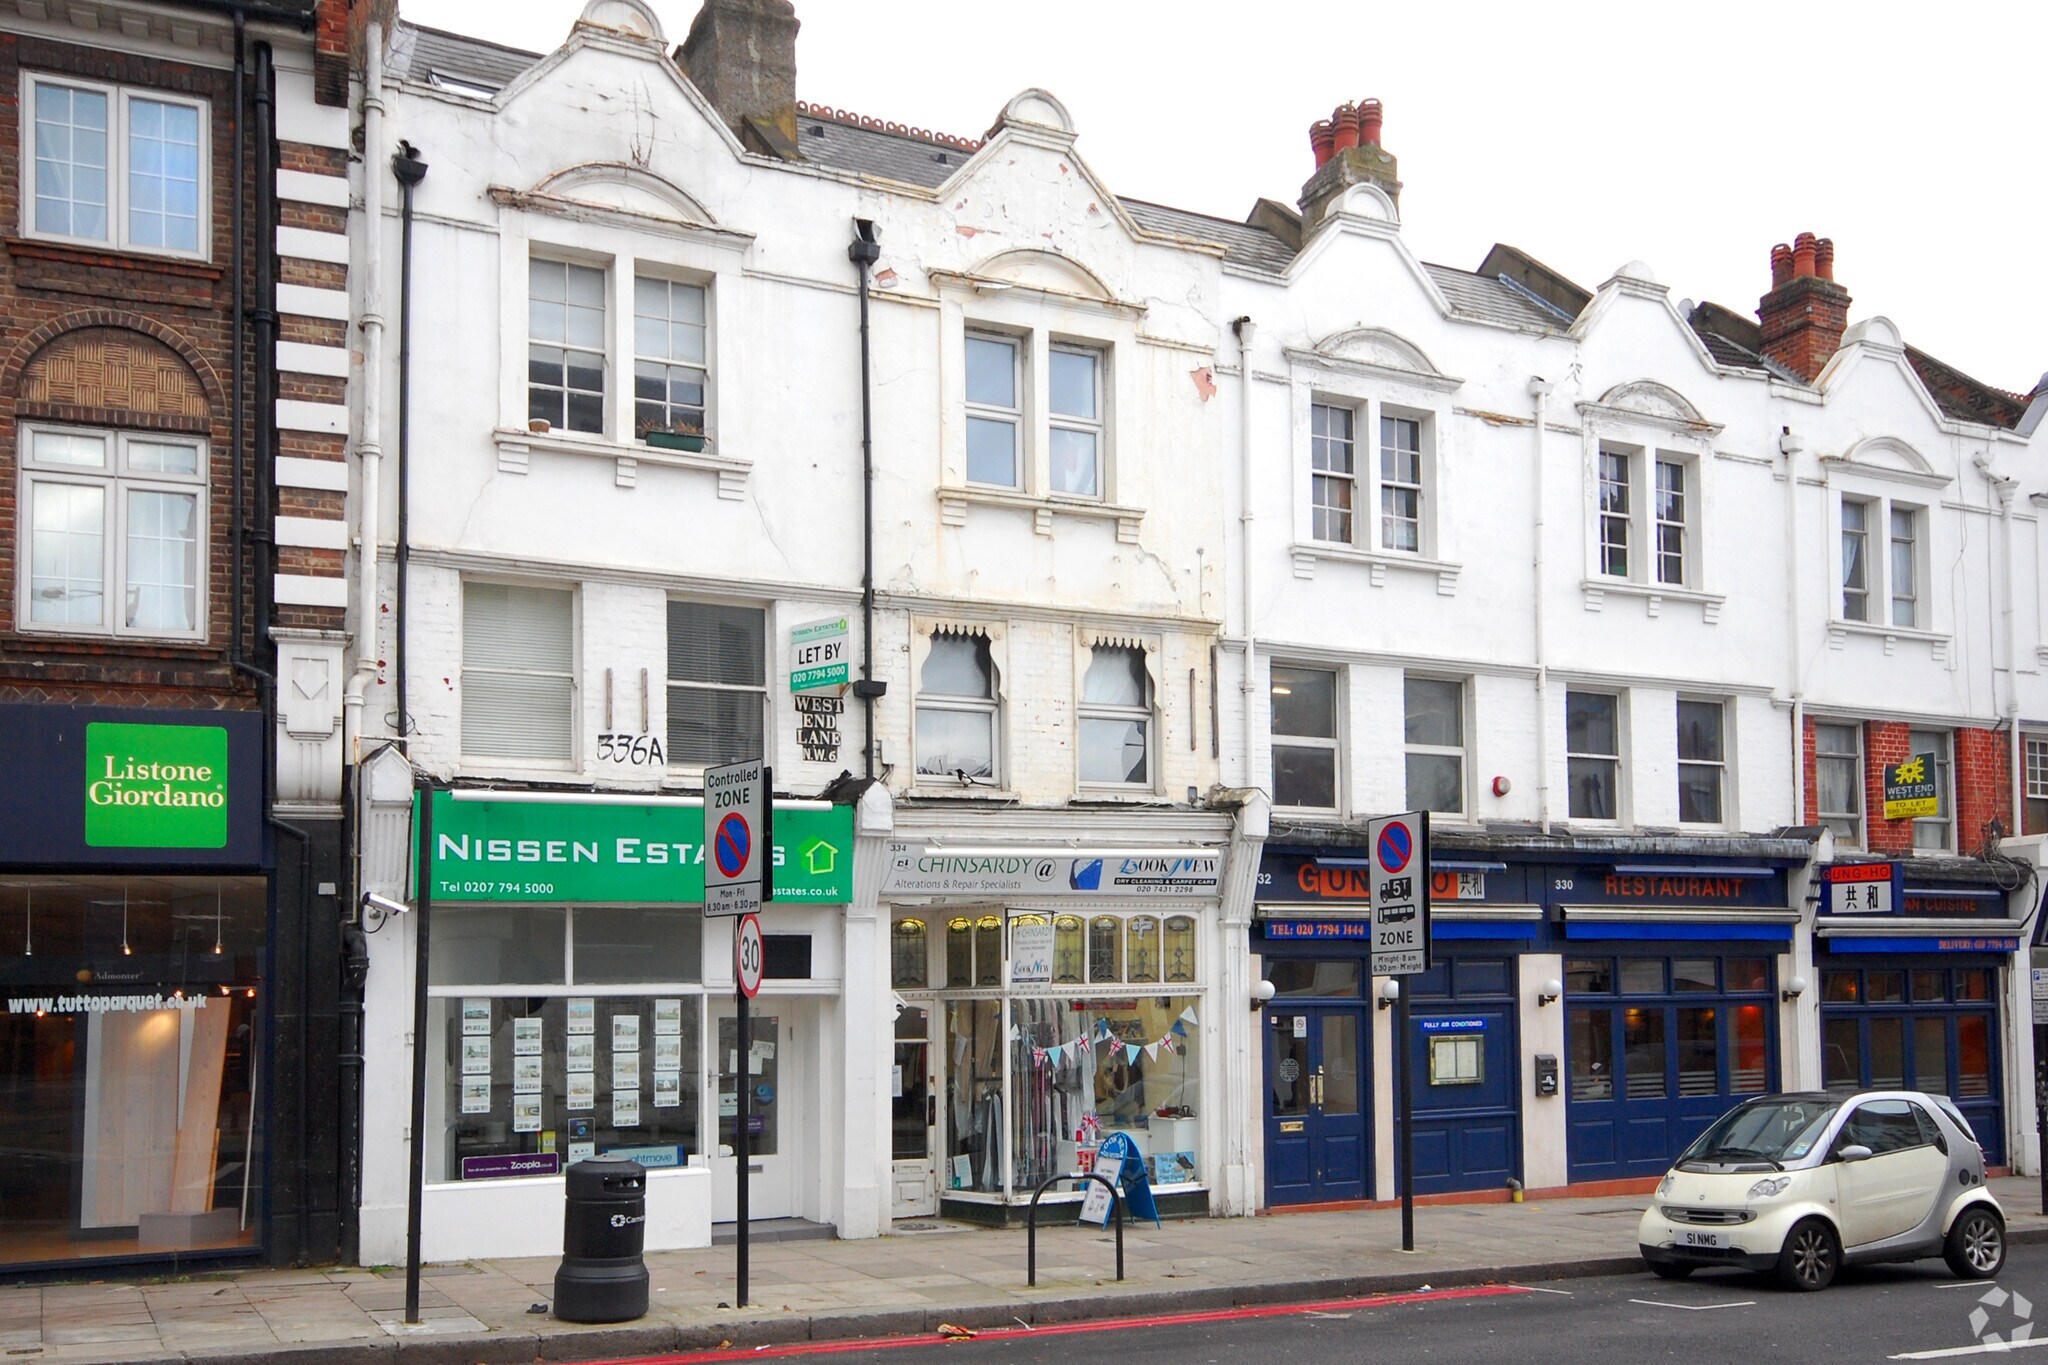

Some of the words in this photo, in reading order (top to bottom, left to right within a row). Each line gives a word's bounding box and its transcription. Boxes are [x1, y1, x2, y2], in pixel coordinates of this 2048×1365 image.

[798, 645, 821, 665] LET
[825, 642, 841, 660] BY
[793, 672, 806, 683] 020
[808, 668, 825, 680] 7794
[827, 665, 845, 677] 5000
[795, 697, 844, 713] WEST
[803, 714, 836, 728] END
[797, 731, 841, 746] LANE
[597, 734, 664, 765] 336A
[104, 755, 212, 781] Listone
[708, 767, 758, 788] Controlled
[89, 781, 224, 807] Giordano
[1887, 786, 1913, 795] WEST
[1915, 784, 1934, 792] END
[1890, 792, 1931, 800] ESTATES
[715, 787, 750, 809] ZONE
[616, 837, 785, 866] ESTS
[918, 858, 1033, 873] CHINSARDY
[1298, 864, 1449, 893] GUNO
[1822, 867, 1889, 880] GUNG-HO
[440, 881, 460, 892] Tel
[464, 881, 494, 893] 0207
[499, 882, 520, 893] 794
[524, 883, 554, 894] 5000
[894, 880, 940, 888] Alterations
[943, 880, 950, 888] &
[952, 880, 978, 890] Repair
[980, 880, 1021, 890] Specialists
[1555, 880, 1573, 890] 330
[1605, 875, 1743, 897] RESTAURANT
[720, 889, 733, 898] Mon
[737, 888, 745, 896] Fri
[1845, 885, 1878, 910] 共和
[1925, 899, 1976, 911] CUISINE
[1271, 925, 1293, 935] TEL:
[1296, 925, 1313, 935] 020
[1317, 925, 1339, 935] 7794
[1380, 931, 1413, 945] ZONE
[741, 936, 760, 973] 30
[95, 971, 139, 980] Admonter
[1697, 1233, 1717, 1246] NMG
